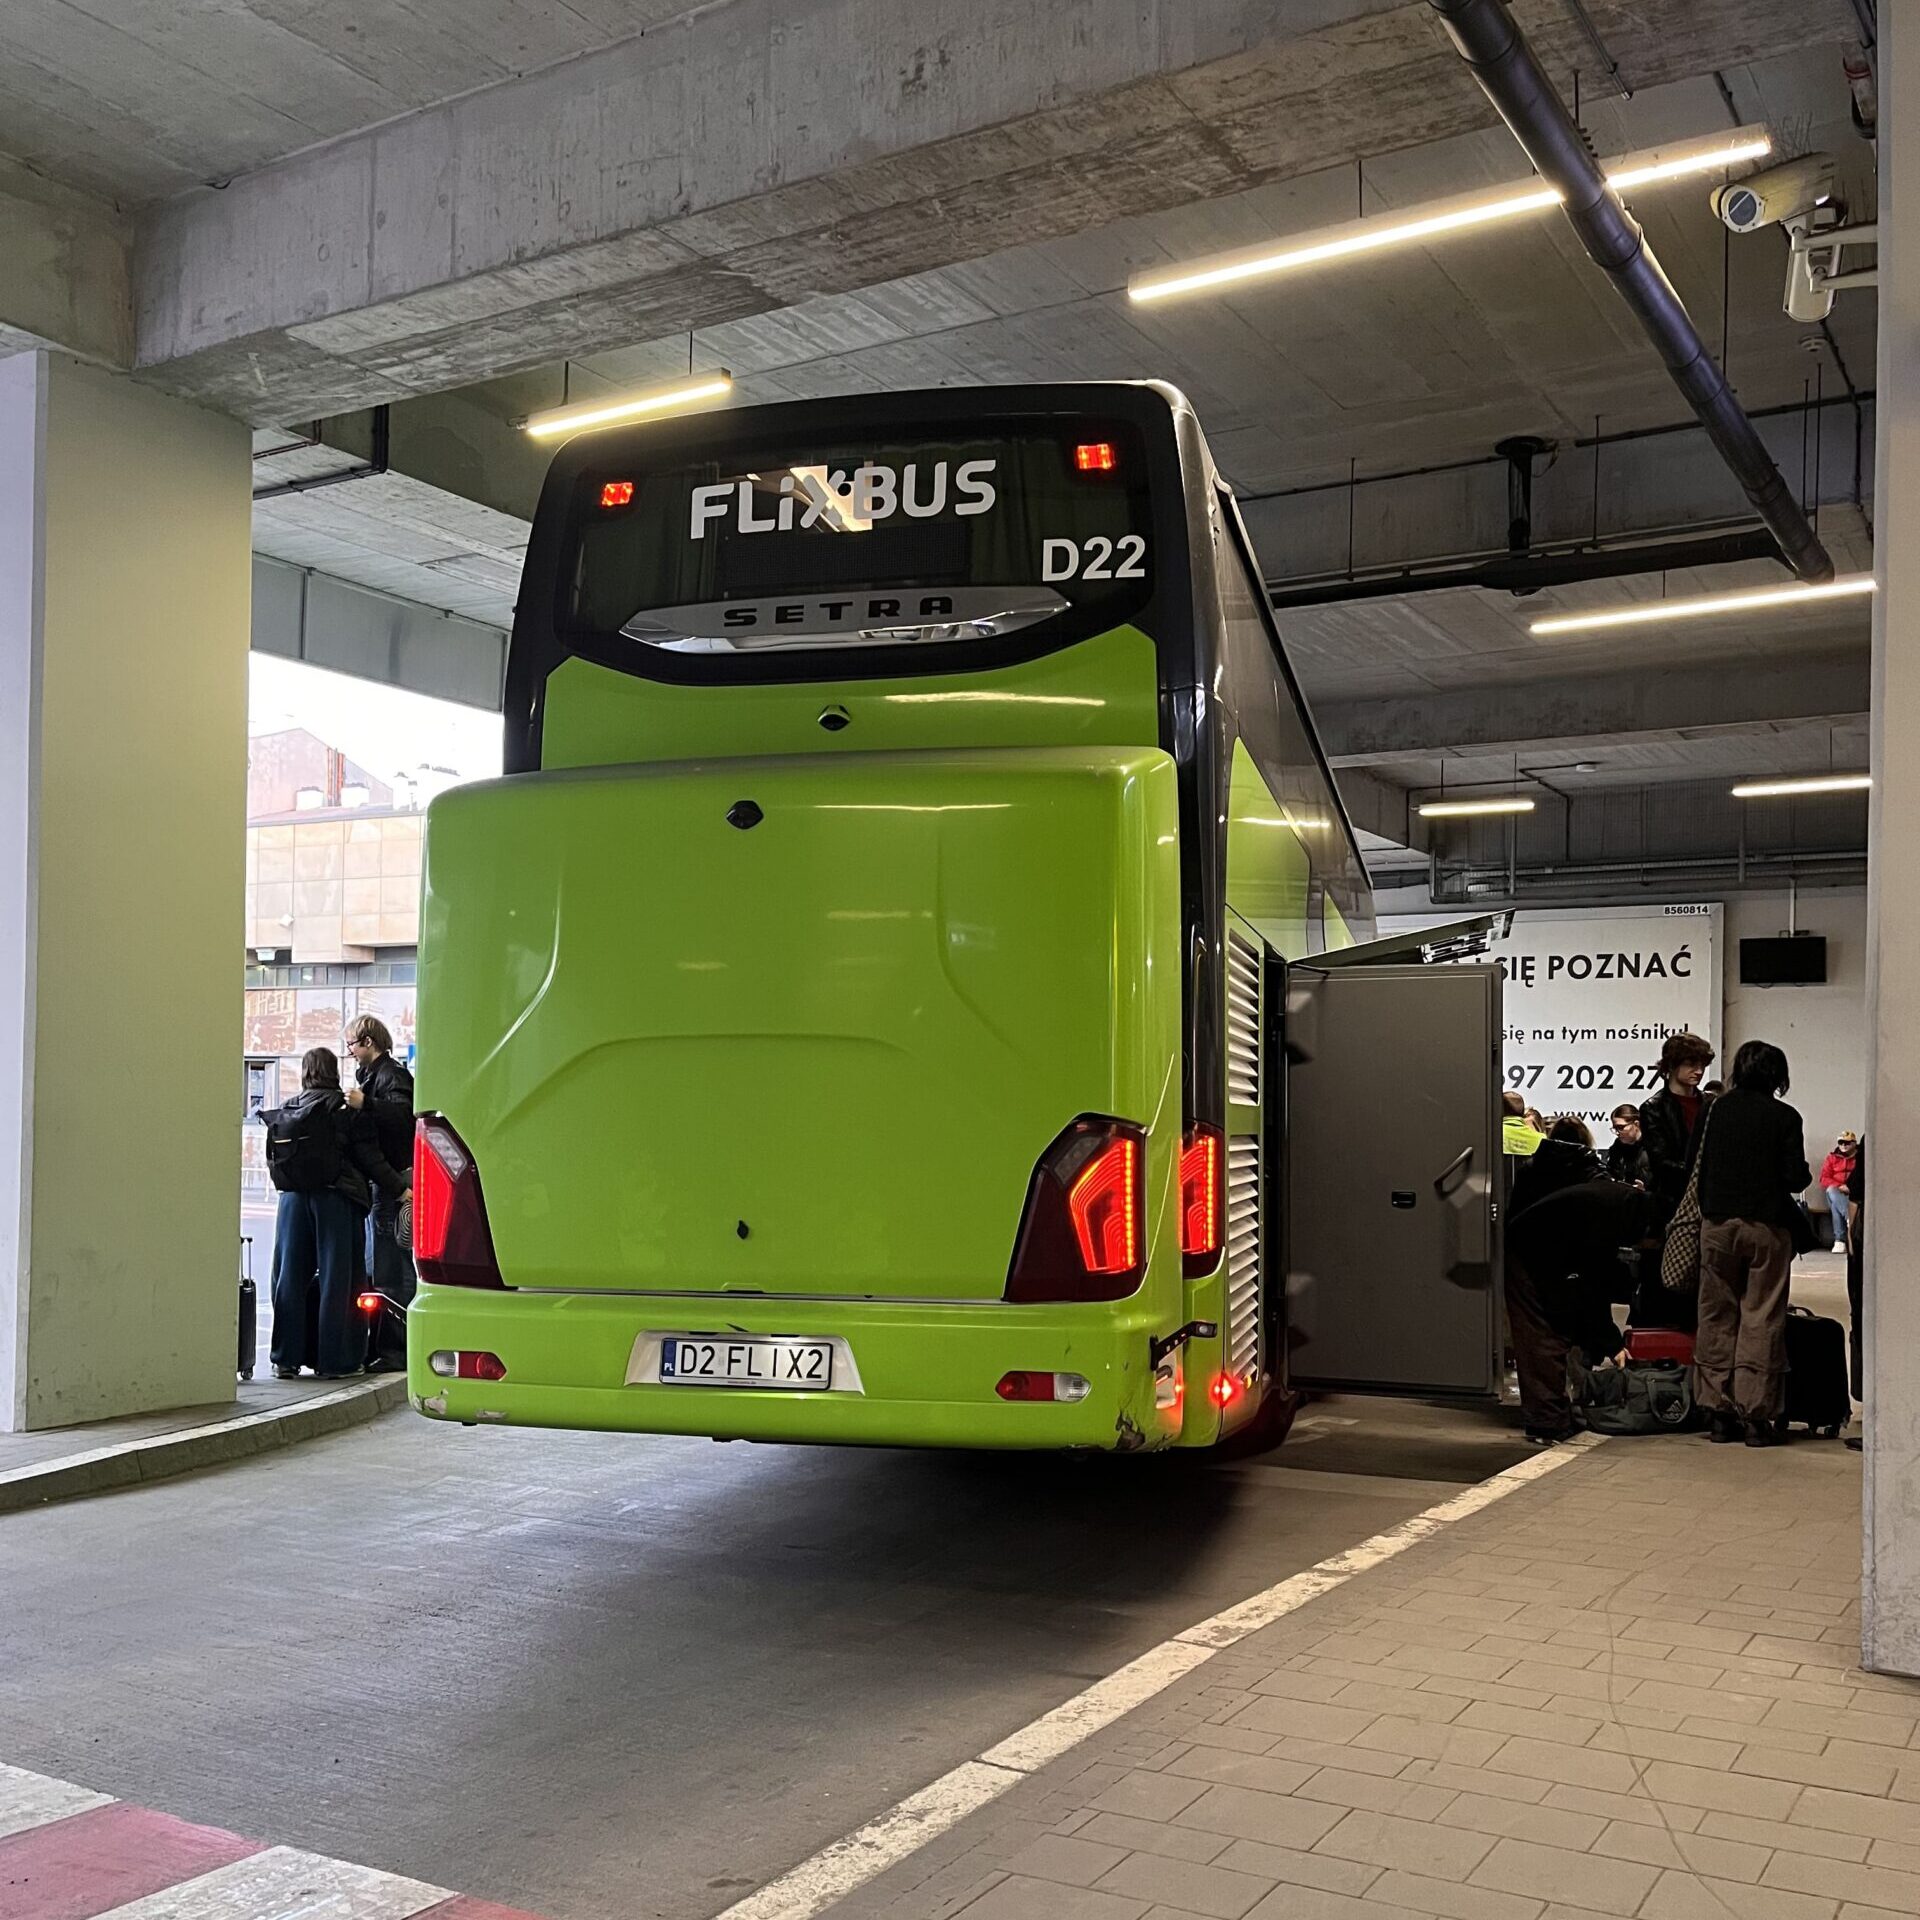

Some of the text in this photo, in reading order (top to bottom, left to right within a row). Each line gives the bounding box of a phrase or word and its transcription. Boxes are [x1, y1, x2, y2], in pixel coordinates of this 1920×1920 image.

[1042, 535, 1146, 582] D22
[723, 596, 953, 628] SETRA
[1664, 905, 1708, 915] 8560814
[1548, 944, 1692, 980] POZNAĆ
[1532, 1028, 1555, 1040] na
[1562, 1026, 1598, 1044] tym
[1503, 1065, 1545, 1089] 97
[1556, 1064, 1614, 1090] 202
[664, 1362, 674, 1371] PL
[680, 1344, 715, 1375] D2
